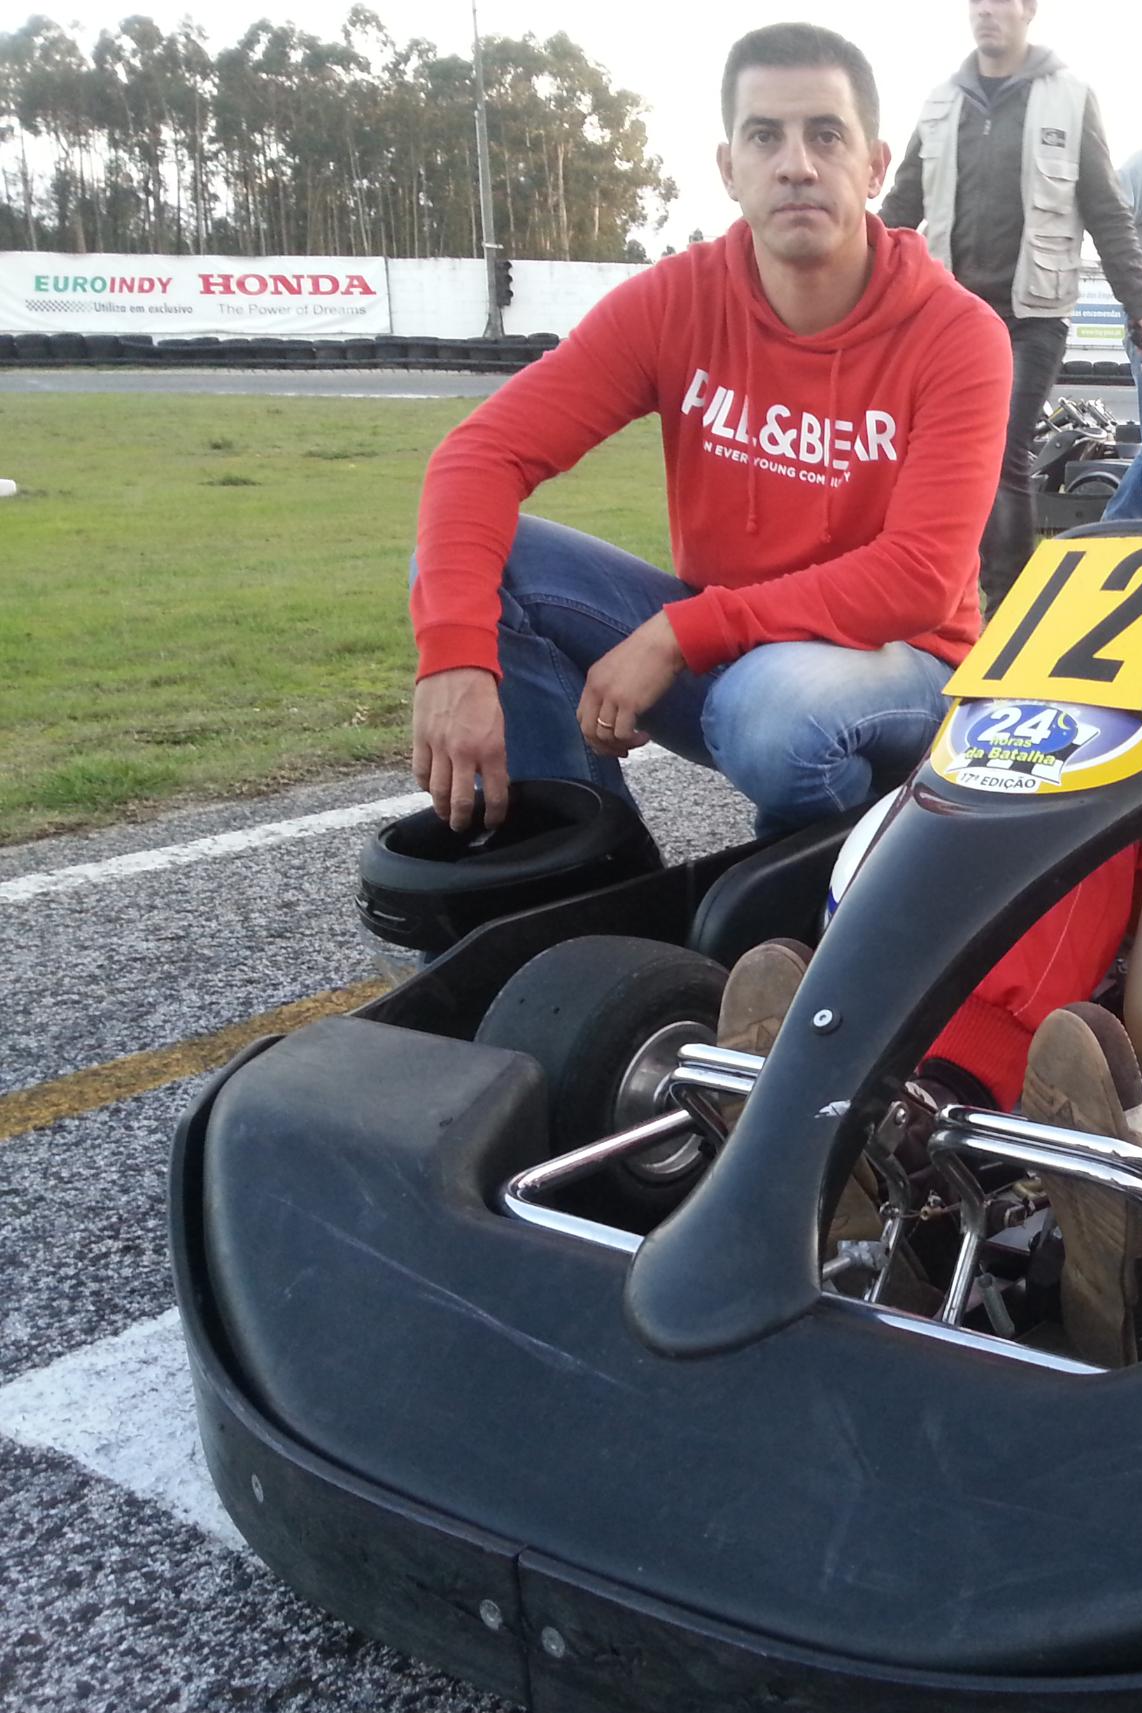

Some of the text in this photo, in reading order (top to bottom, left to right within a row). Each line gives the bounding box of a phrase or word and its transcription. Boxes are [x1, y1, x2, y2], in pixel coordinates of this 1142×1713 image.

[35, 275, 172, 294] EUROINDY
[199, 274, 377, 295] HONDA
[94, 302, 193, 314] Utiliza em exclusivo
[219, 304, 367, 315] The Power of Dreams
[715, 444, 750, 465] EVER
[753, 457, 796, 479] YOUNG
[977, 707, 1058, 745] 24
[965, 746, 1056, 766] da Batalha
[980, 776, 1037, 790] EDIÇÃO
